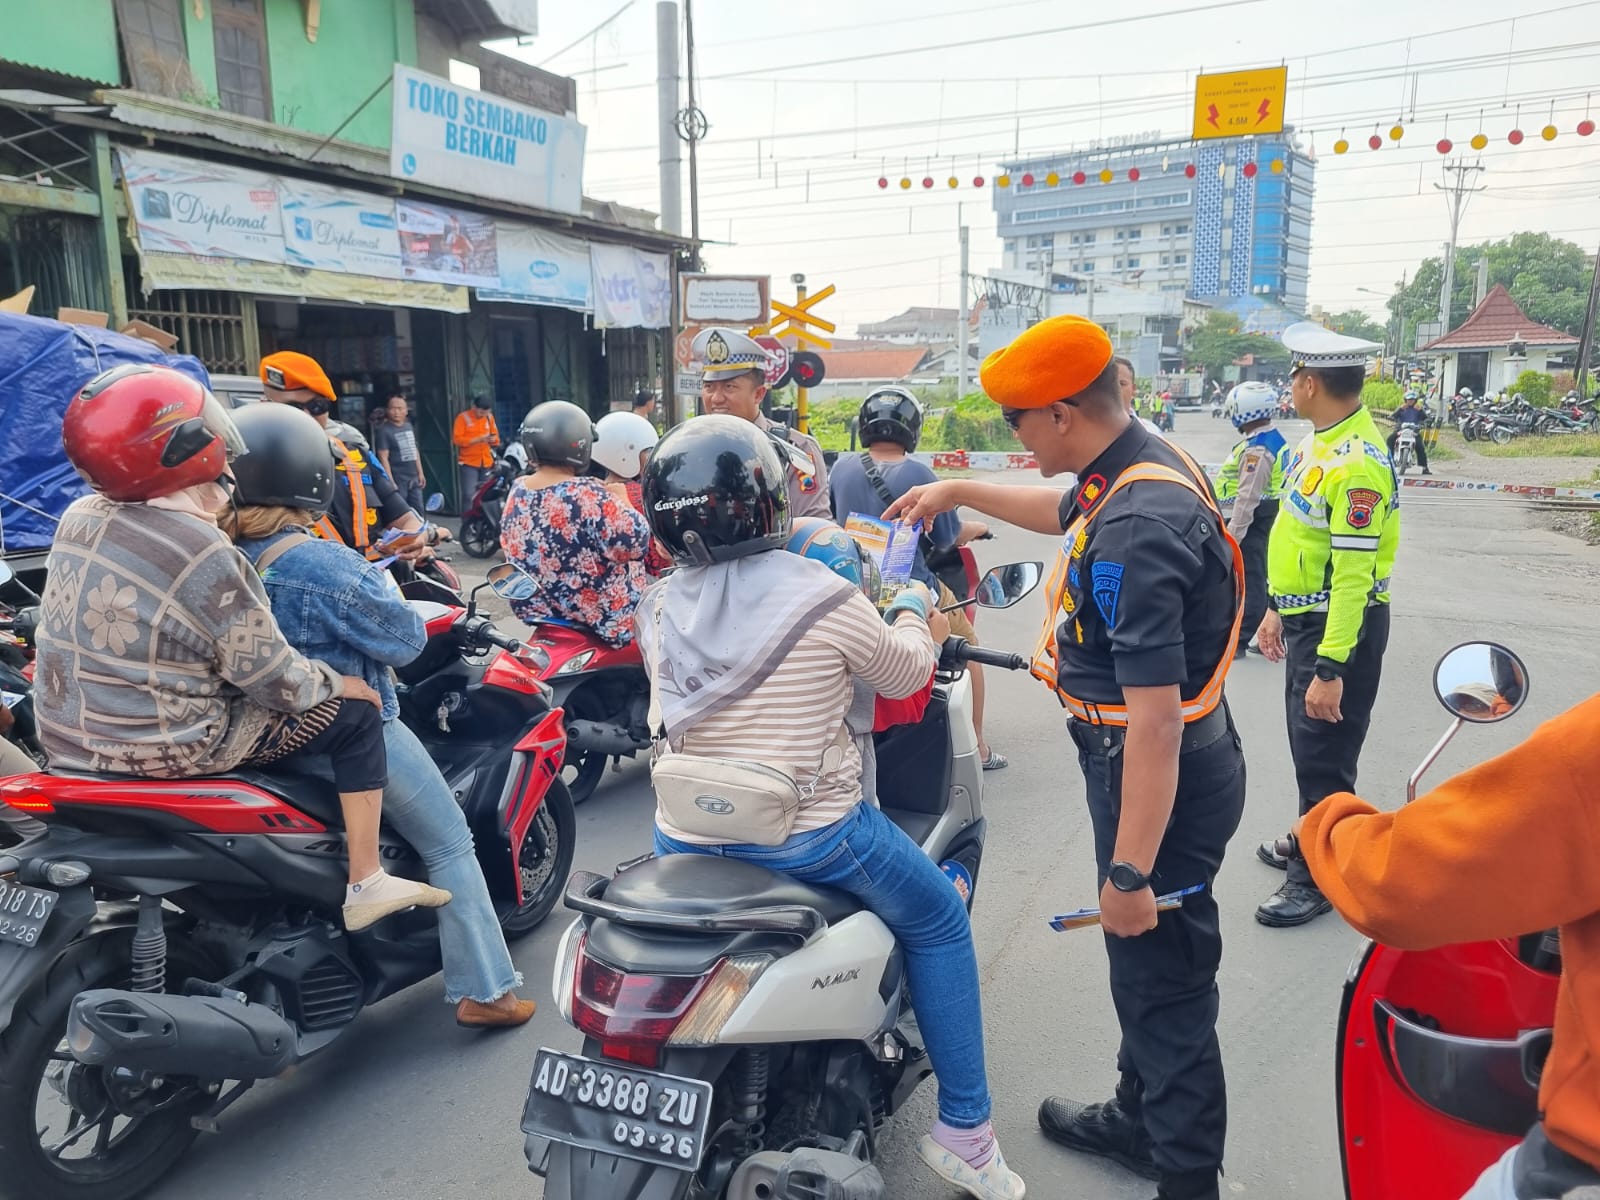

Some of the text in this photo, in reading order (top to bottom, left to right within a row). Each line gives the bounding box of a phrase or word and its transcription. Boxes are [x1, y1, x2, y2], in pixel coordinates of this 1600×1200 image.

[407, 78, 547, 145] TOKO SEMBAKO
[445, 121, 517, 166] BERKAH
[173, 191, 267, 233] Diplomat
[314, 219, 380, 253] Diplomat
[654, 494, 709, 511] Cargloss
[26, 892, 51, 919] TS
[0, 920, 37, 942] 2.26
[534, 1057, 698, 1126] AD 3388 ZU
